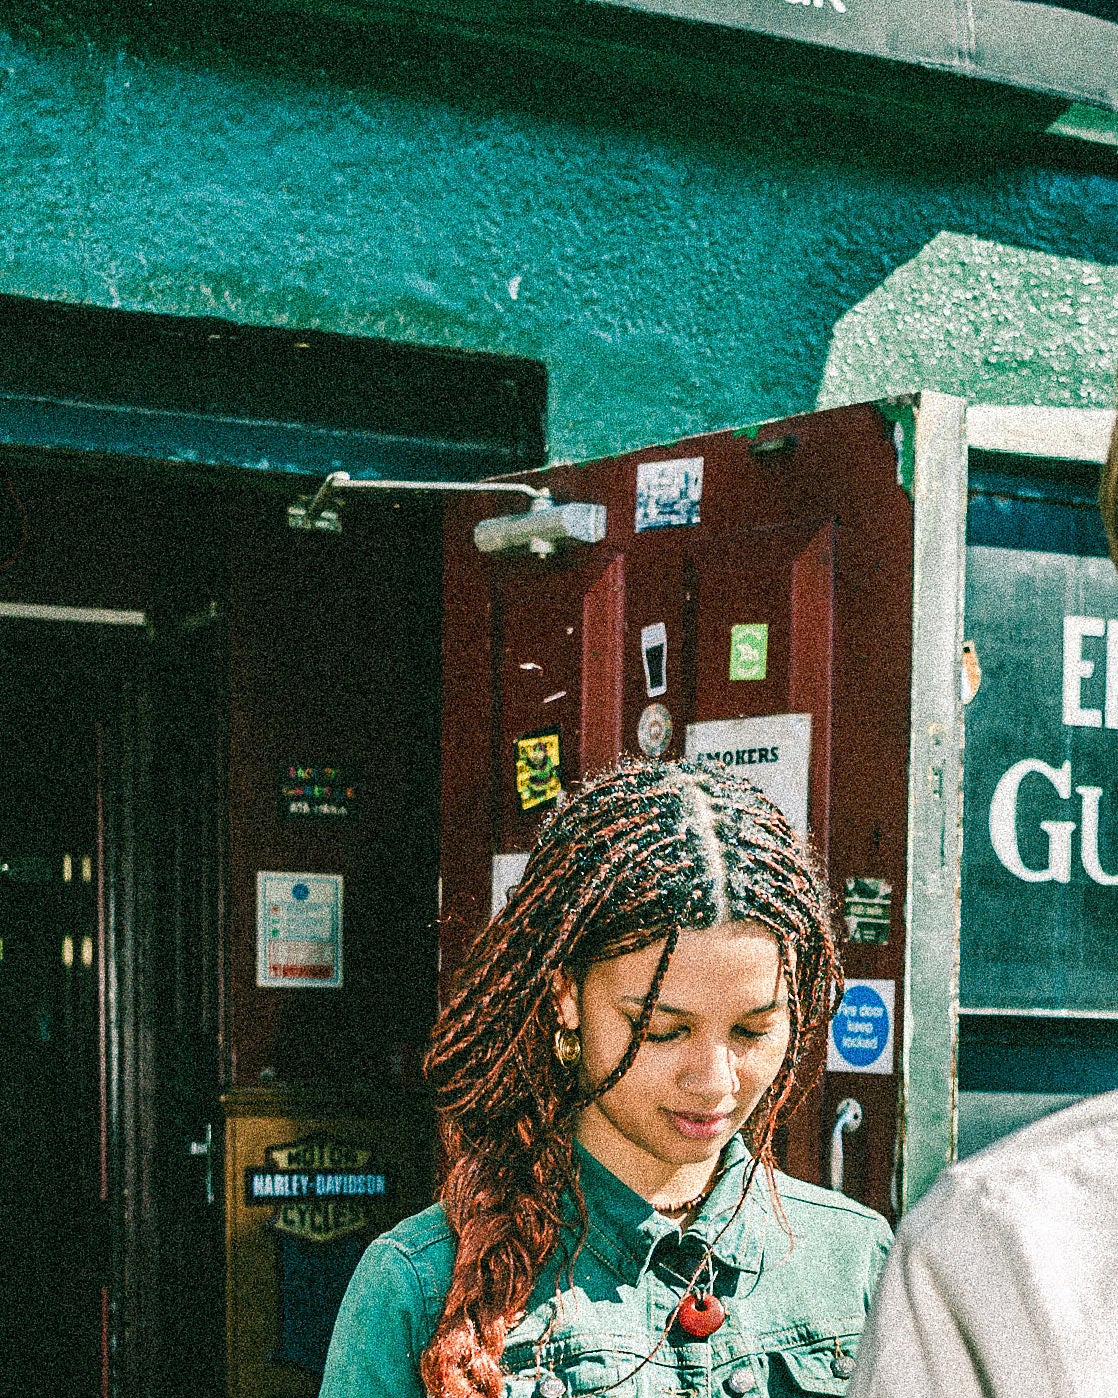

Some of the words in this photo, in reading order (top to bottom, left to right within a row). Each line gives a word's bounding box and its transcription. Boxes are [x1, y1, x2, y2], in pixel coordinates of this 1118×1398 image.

[859, 1004, 884, 1018] door
[847, 1020, 874, 1034] keep
[842, 1035, 878, 1050] locked
[252, 1172, 387, 1198] HARLEY-DAVIDSON
